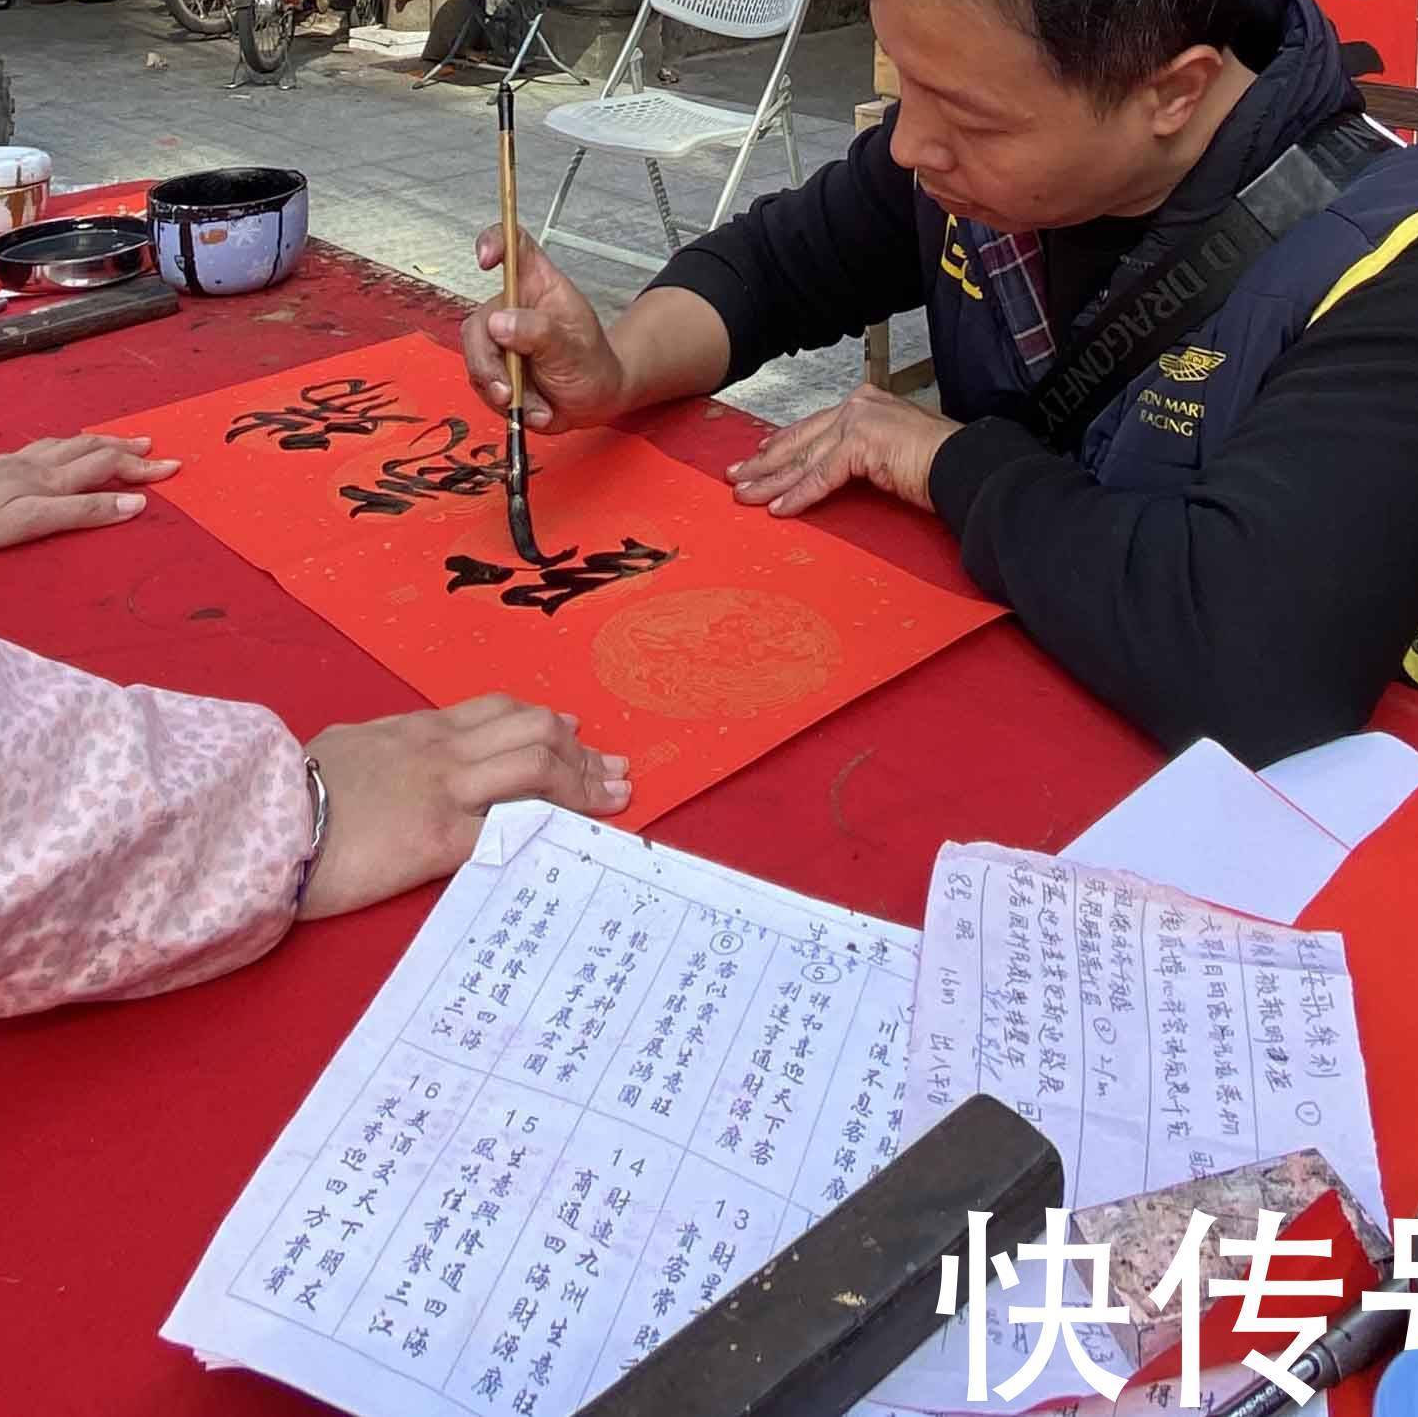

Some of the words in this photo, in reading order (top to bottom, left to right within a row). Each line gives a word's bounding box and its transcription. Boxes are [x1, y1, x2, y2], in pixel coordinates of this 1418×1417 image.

[1140, 409, 1194, 437] RACING
[546, 868, 560, 882] 8
[409, 1074, 441, 1099] 16
[504, 1110, 538, 1135] 15
[612, 1148, 645, 1177] 14
[715, 1199, 749, 1230] 13
